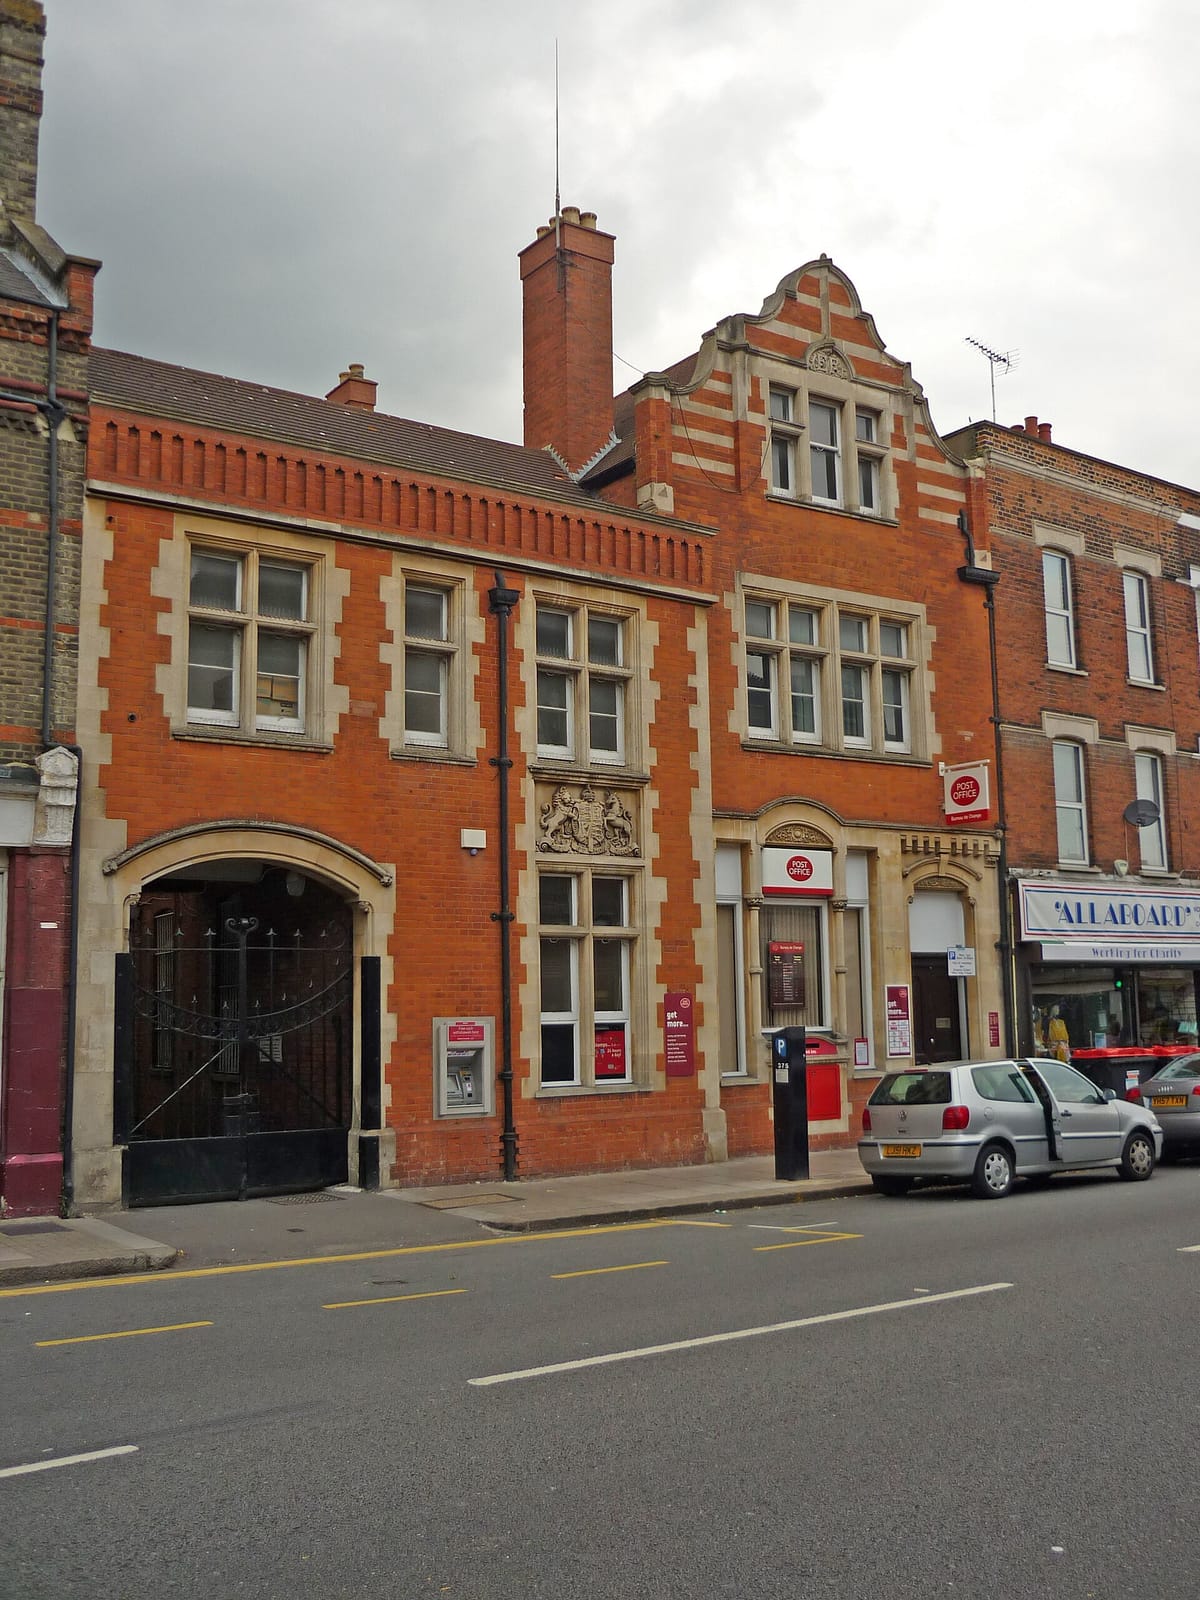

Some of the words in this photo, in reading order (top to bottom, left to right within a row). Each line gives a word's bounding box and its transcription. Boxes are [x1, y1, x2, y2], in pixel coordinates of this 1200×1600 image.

[956, 780, 974, 791] POST
[953, 789, 977, 800] OFFICE
[792, 860, 808, 868] POST
[789, 868, 811, 876] OFFICE
[1092, 947, 1131, 959] Working
[1133, 948, 1147, 958] for
[1150, 948, 1182, 959] Charity
[667, 1011, 678, 1021] get
